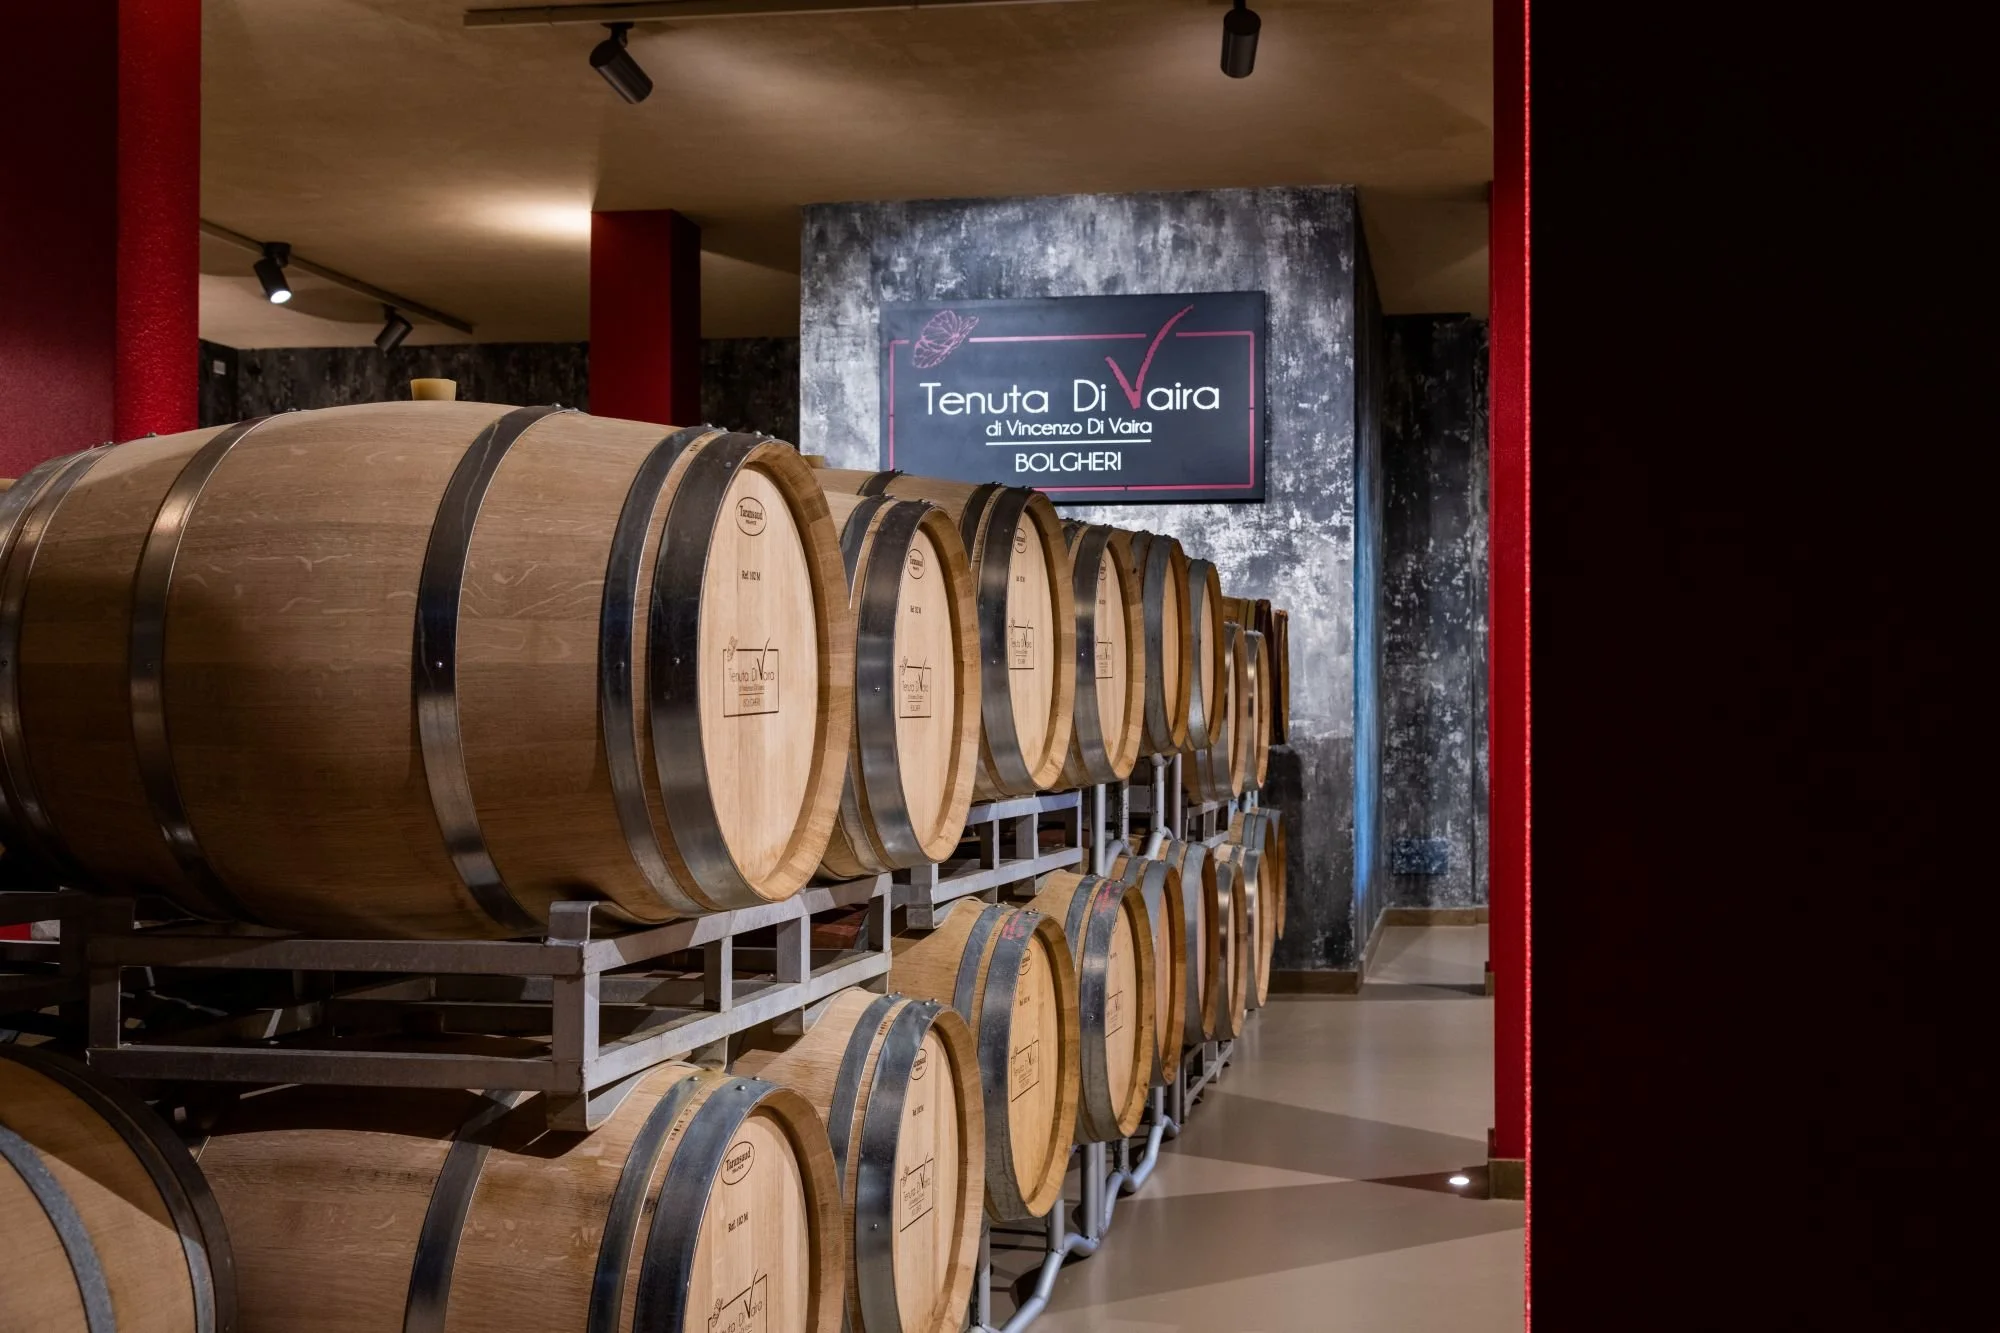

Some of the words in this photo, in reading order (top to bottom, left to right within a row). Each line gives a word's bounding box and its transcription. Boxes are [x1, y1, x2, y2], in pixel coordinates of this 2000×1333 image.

[919, 382, 1049, 415] Tenuta
[1073, 379, 1107, 412] Di
[986, 420, 1002, 437] di
[1006, 419, 1082, 436] Vincenzo
[1087, 418, 1104, 435] Di
[1108, 417, 1152, 434] Vaira
[1015, 451, 1122, 472] BOLGHERI
